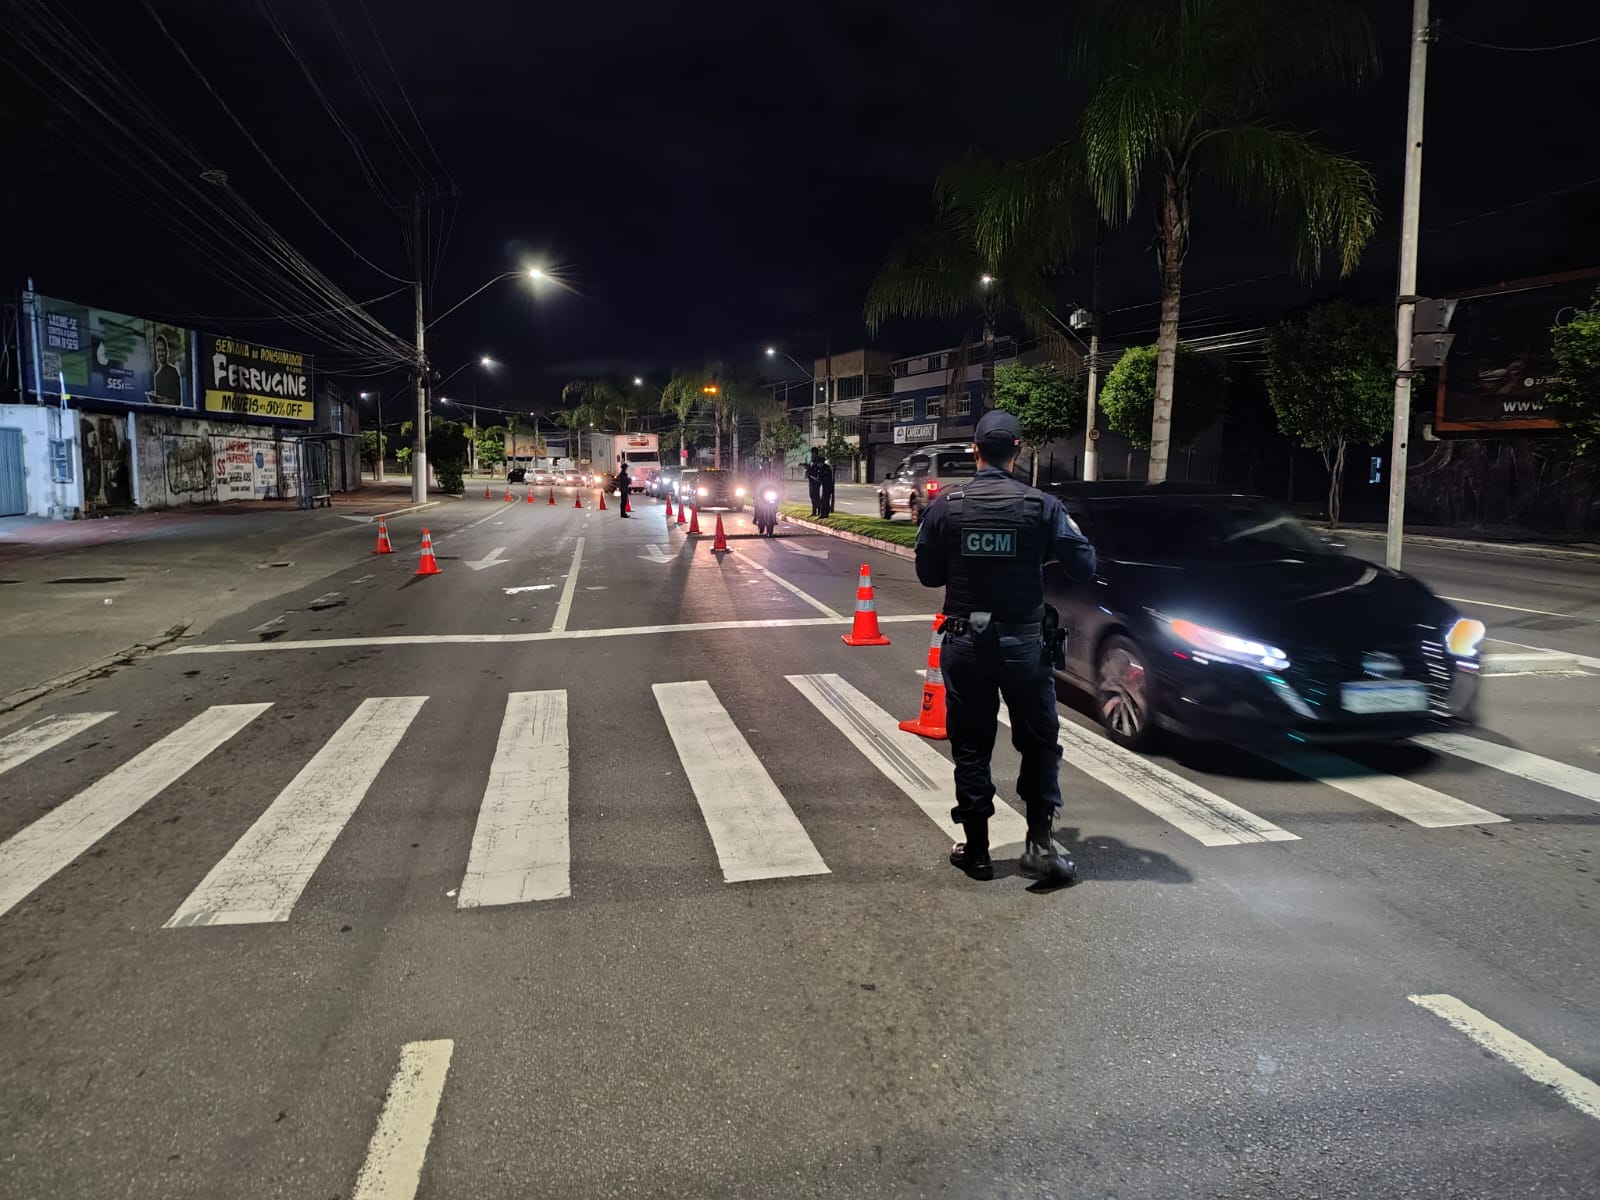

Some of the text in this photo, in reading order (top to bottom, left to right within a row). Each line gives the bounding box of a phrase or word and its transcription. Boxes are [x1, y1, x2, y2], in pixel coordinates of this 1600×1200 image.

[216, 339, 249, 357] SEMANA
[212, 352, 307, 397] FERRUGINE
[286, 403, 303, 417] OFF
[967, 533, 1011, 552] GCM
